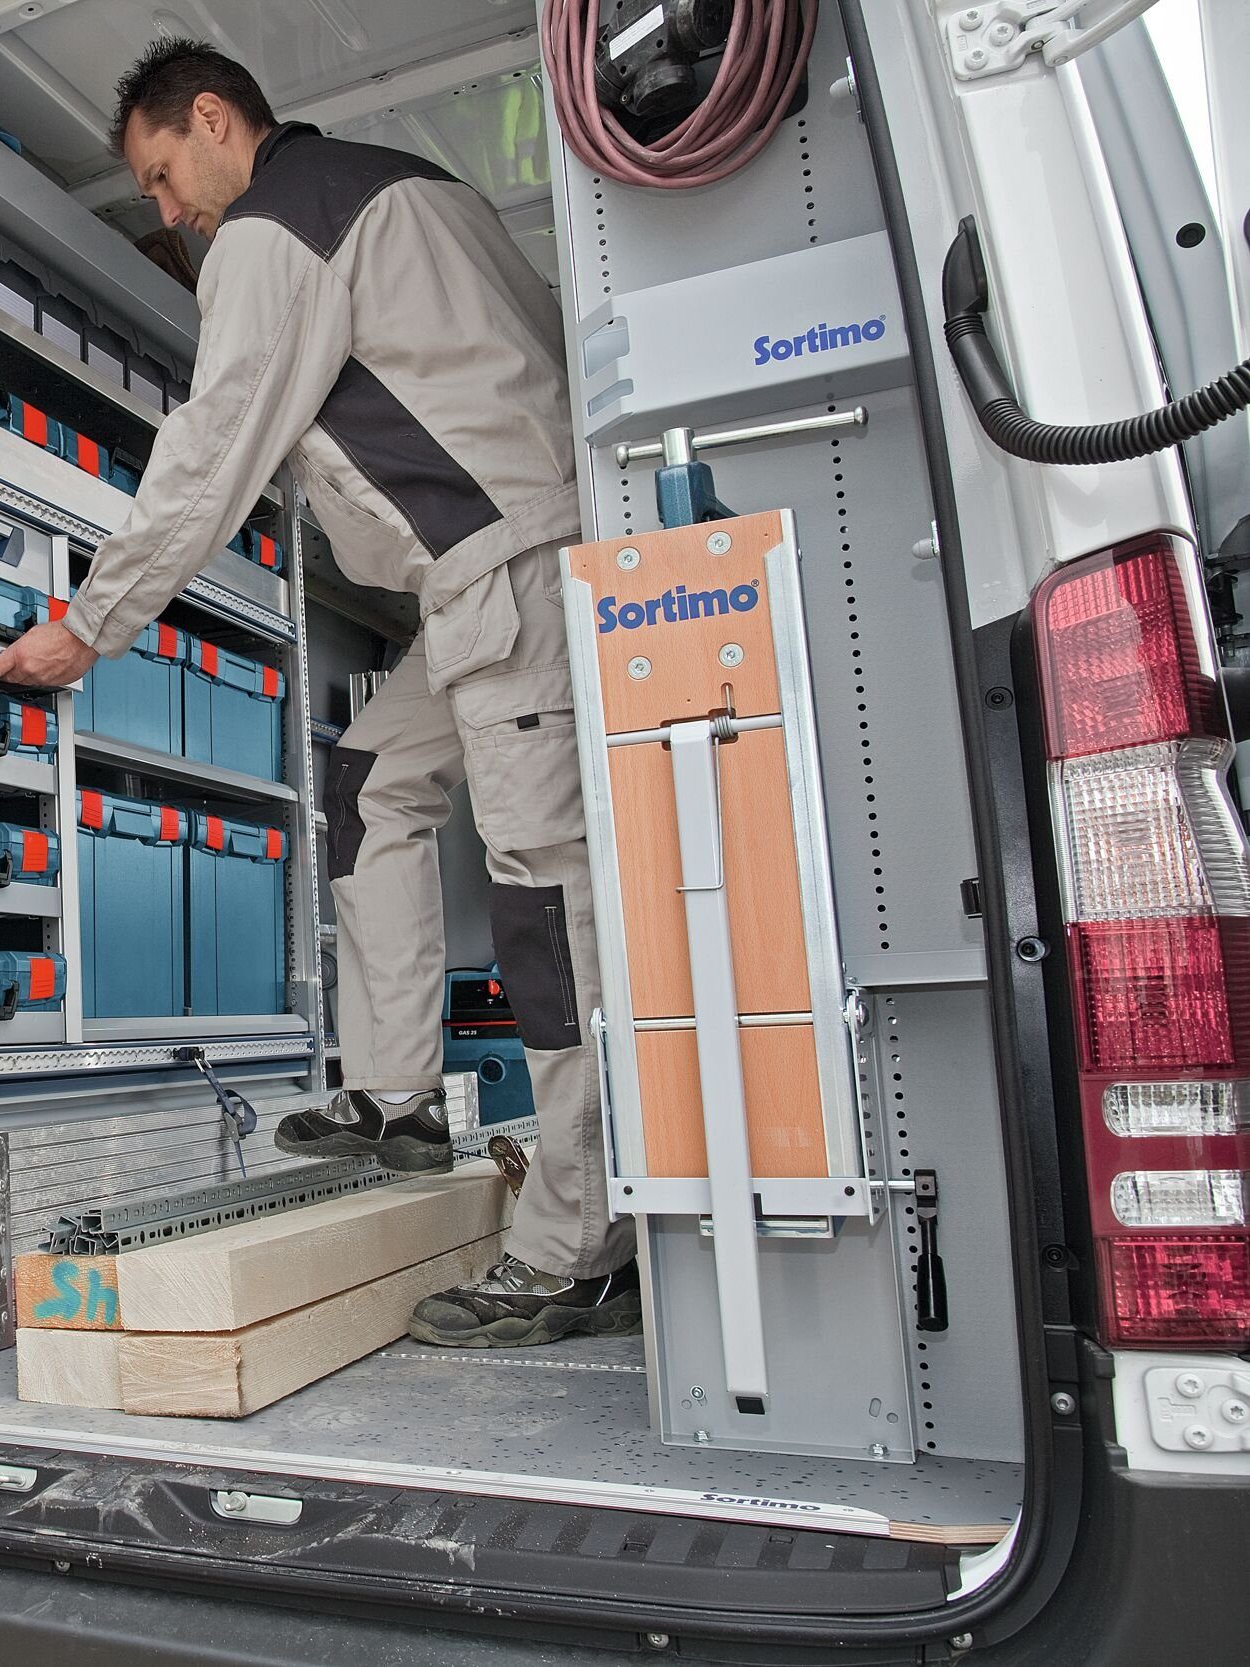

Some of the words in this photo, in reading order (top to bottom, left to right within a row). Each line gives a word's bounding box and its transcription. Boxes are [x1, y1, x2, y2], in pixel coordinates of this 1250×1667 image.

[753, 318, 886, 366] Sortimo
[596, 582, 759, 634] Sortimo
[700, 1493, 821, 1511] Sortimo
